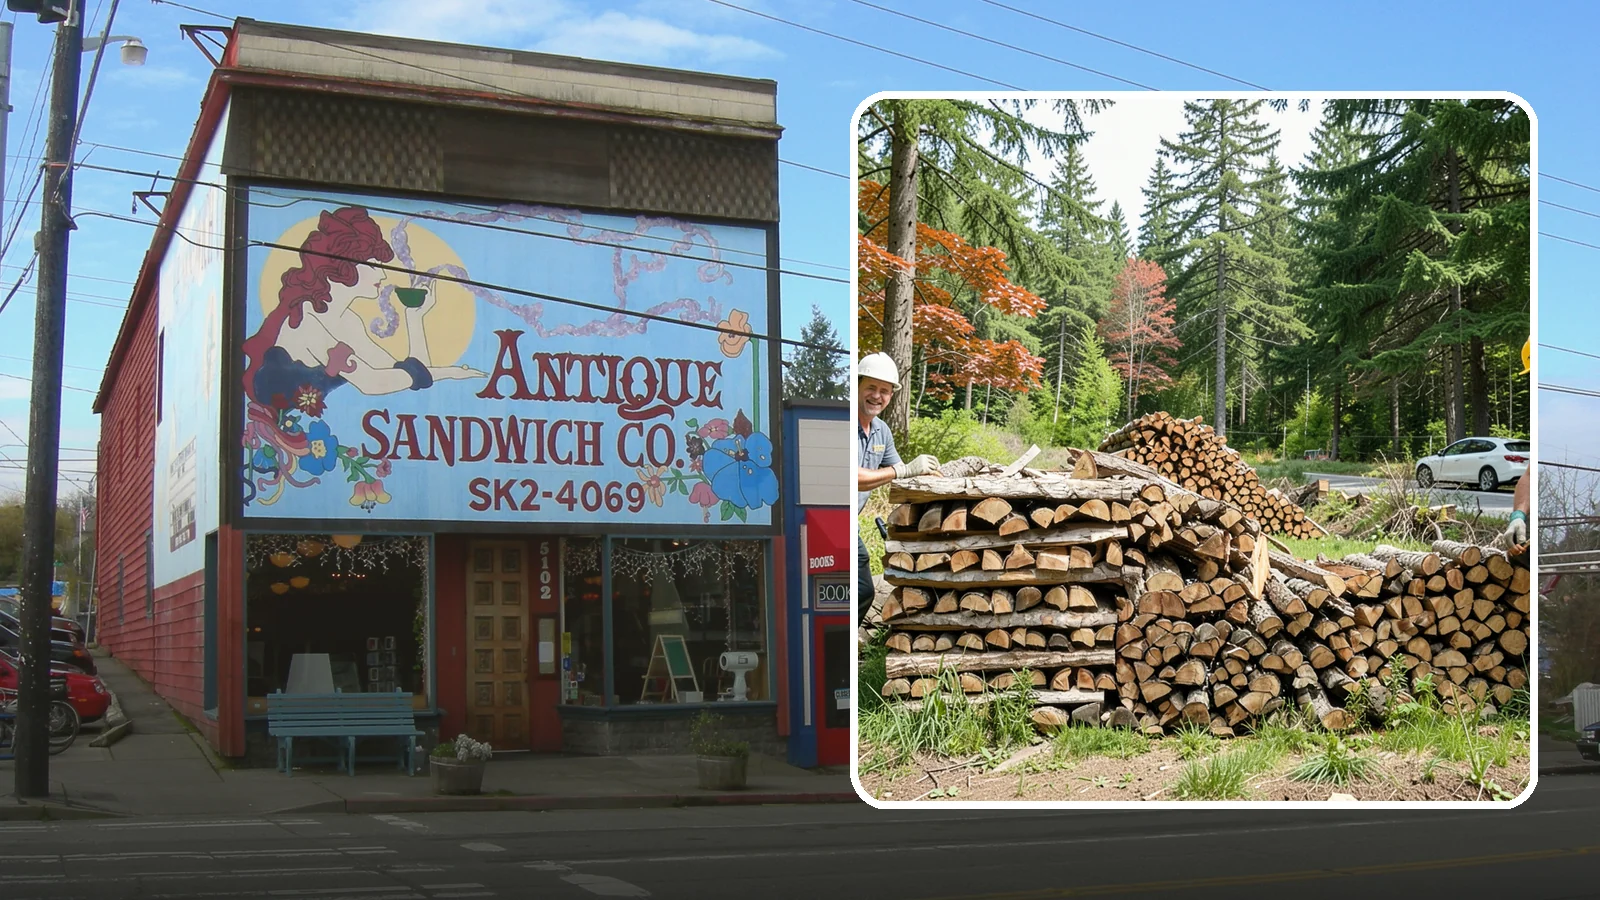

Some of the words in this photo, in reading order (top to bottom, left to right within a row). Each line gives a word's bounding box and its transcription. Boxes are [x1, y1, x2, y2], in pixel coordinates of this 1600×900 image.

[475, 329, 723, 421] ANTIQUE
[361, 409, 604, 467] SANDWICH
[617, 422, 685, 468] CO.
[468, 477, 645, 513] SK2-4069
[540, 541, 552, 599] 5102
[809, 555, 835, 569] BOOKS
